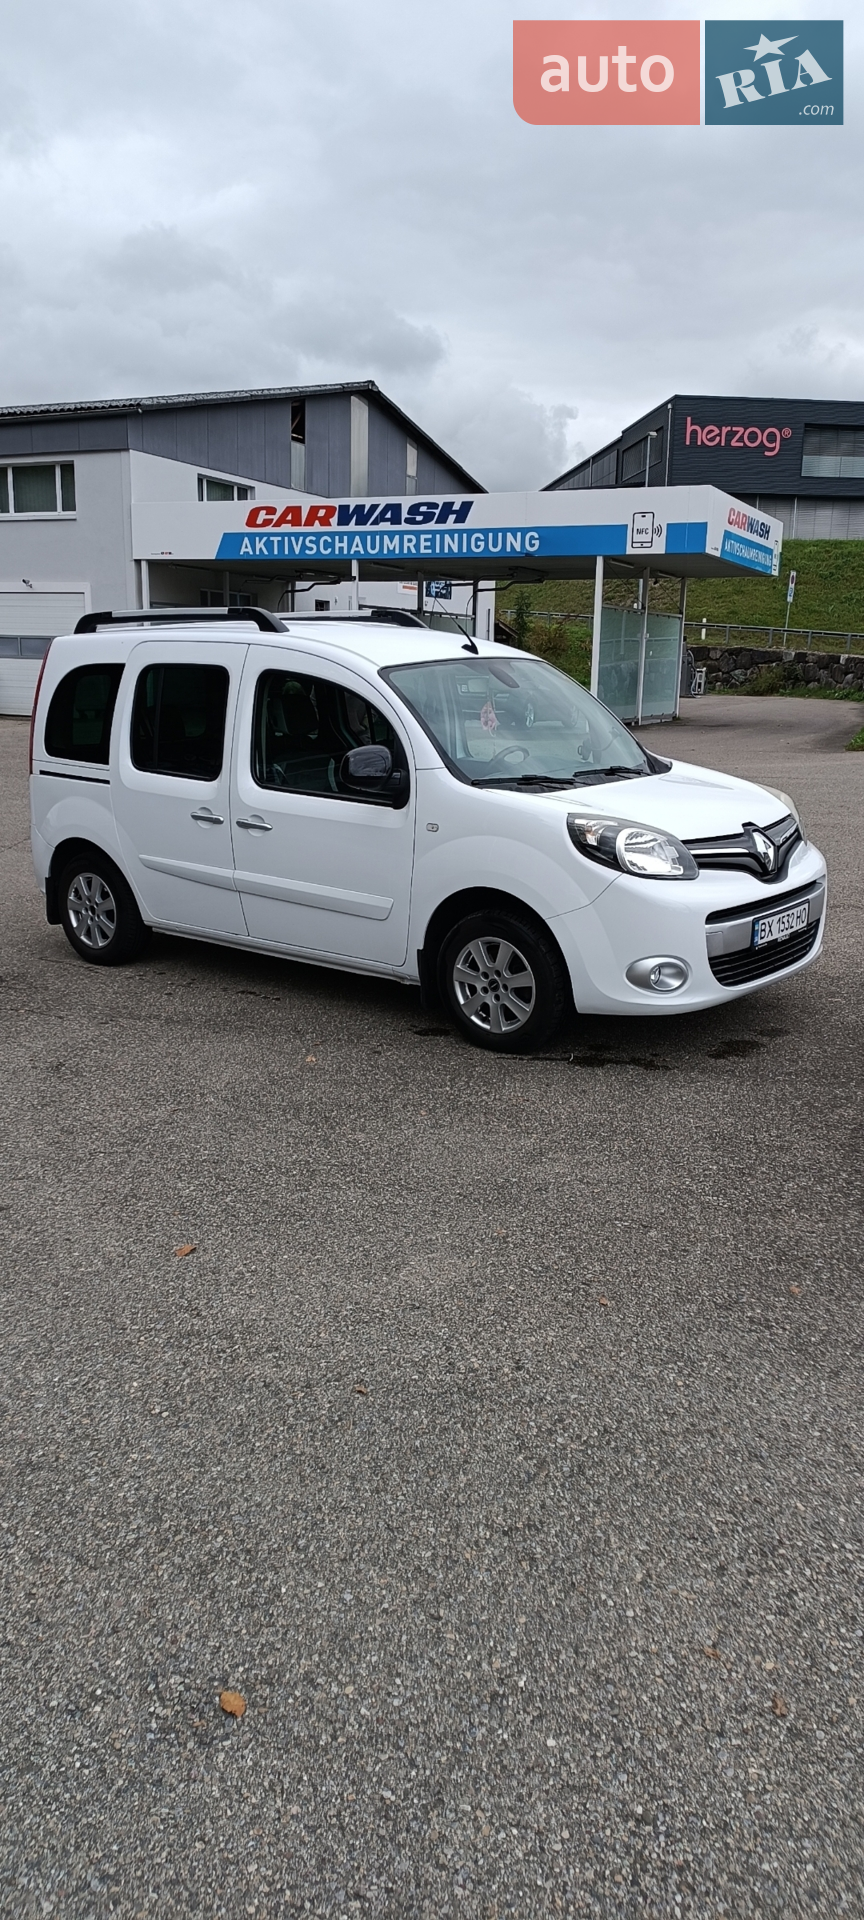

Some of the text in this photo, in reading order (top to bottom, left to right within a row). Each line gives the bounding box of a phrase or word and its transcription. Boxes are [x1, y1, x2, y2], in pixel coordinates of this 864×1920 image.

[245, 501, 475, 528] CARWASH
[727, 507, 771, 541] CARWASH
[239, 531, 541, 556] AKTIVSCHAUMREINIGUNG
[636, 527, 650, 536] NFC
[760, 919, 774, 940] BX
[776, 912, 794, 934] 1532
[796, 907, 806, 927] HO
